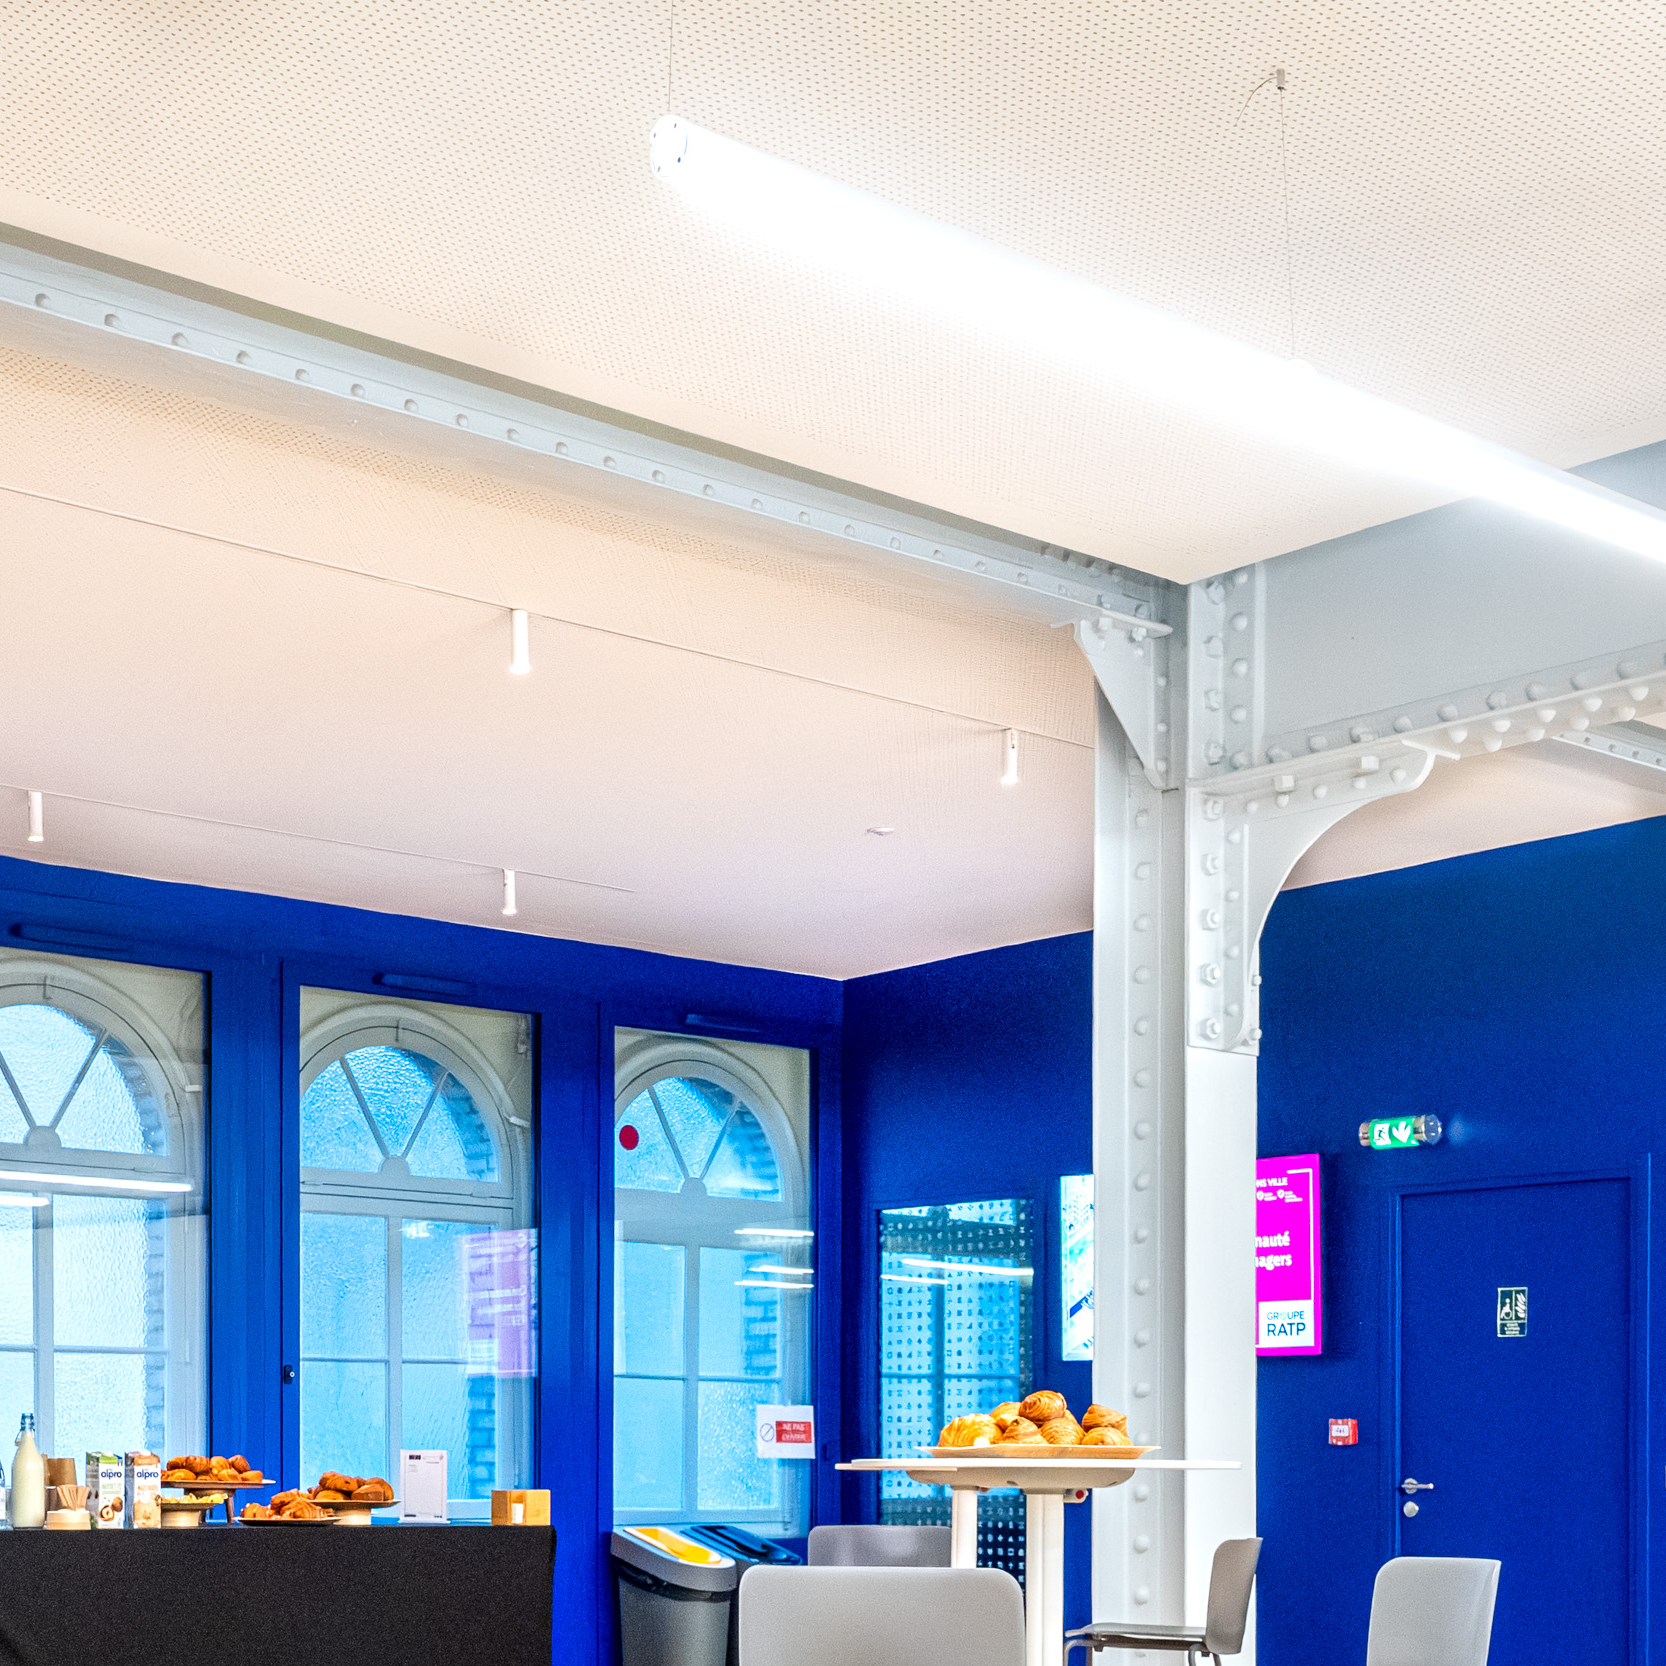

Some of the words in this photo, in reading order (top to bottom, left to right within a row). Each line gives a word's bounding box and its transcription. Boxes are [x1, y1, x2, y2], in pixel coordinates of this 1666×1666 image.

[1267, 1176, 1288, 1186] VILLE
[1266, 1310, 1305, 1321] GROUPE
[1267, 1322, 1306, 1337] RATP
[101, 1468, 122, 1480] alpro
[136, 1468, 159, 1480] alpro
